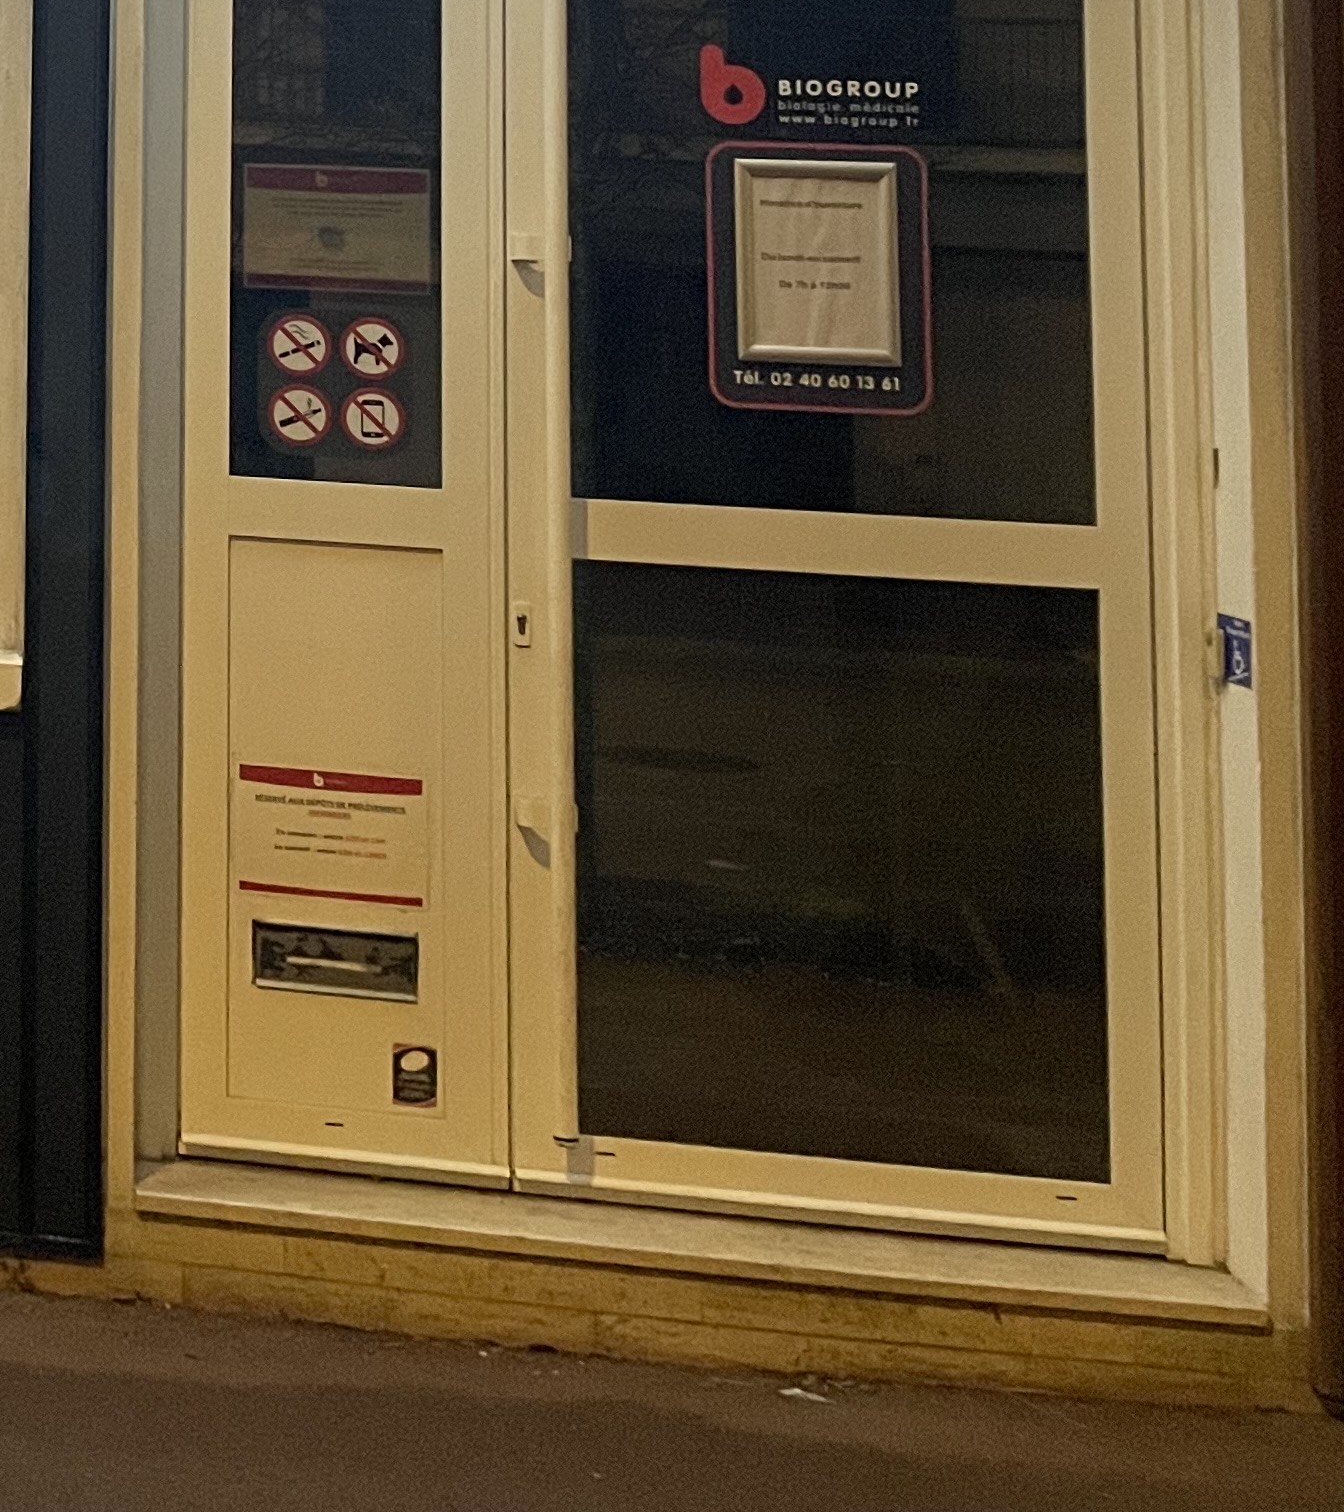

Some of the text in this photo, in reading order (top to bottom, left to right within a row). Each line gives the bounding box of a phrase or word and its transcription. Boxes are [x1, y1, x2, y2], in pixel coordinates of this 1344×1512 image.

[777, 79, 919, 99] BIOGROUP
[770, 372, 793, 387] 02
[799, 373, 822, 387] 40
[828, 374, 851, 389] 60
[856, 375, 875, 390] 13
[881, 376, 900, 391] 61
